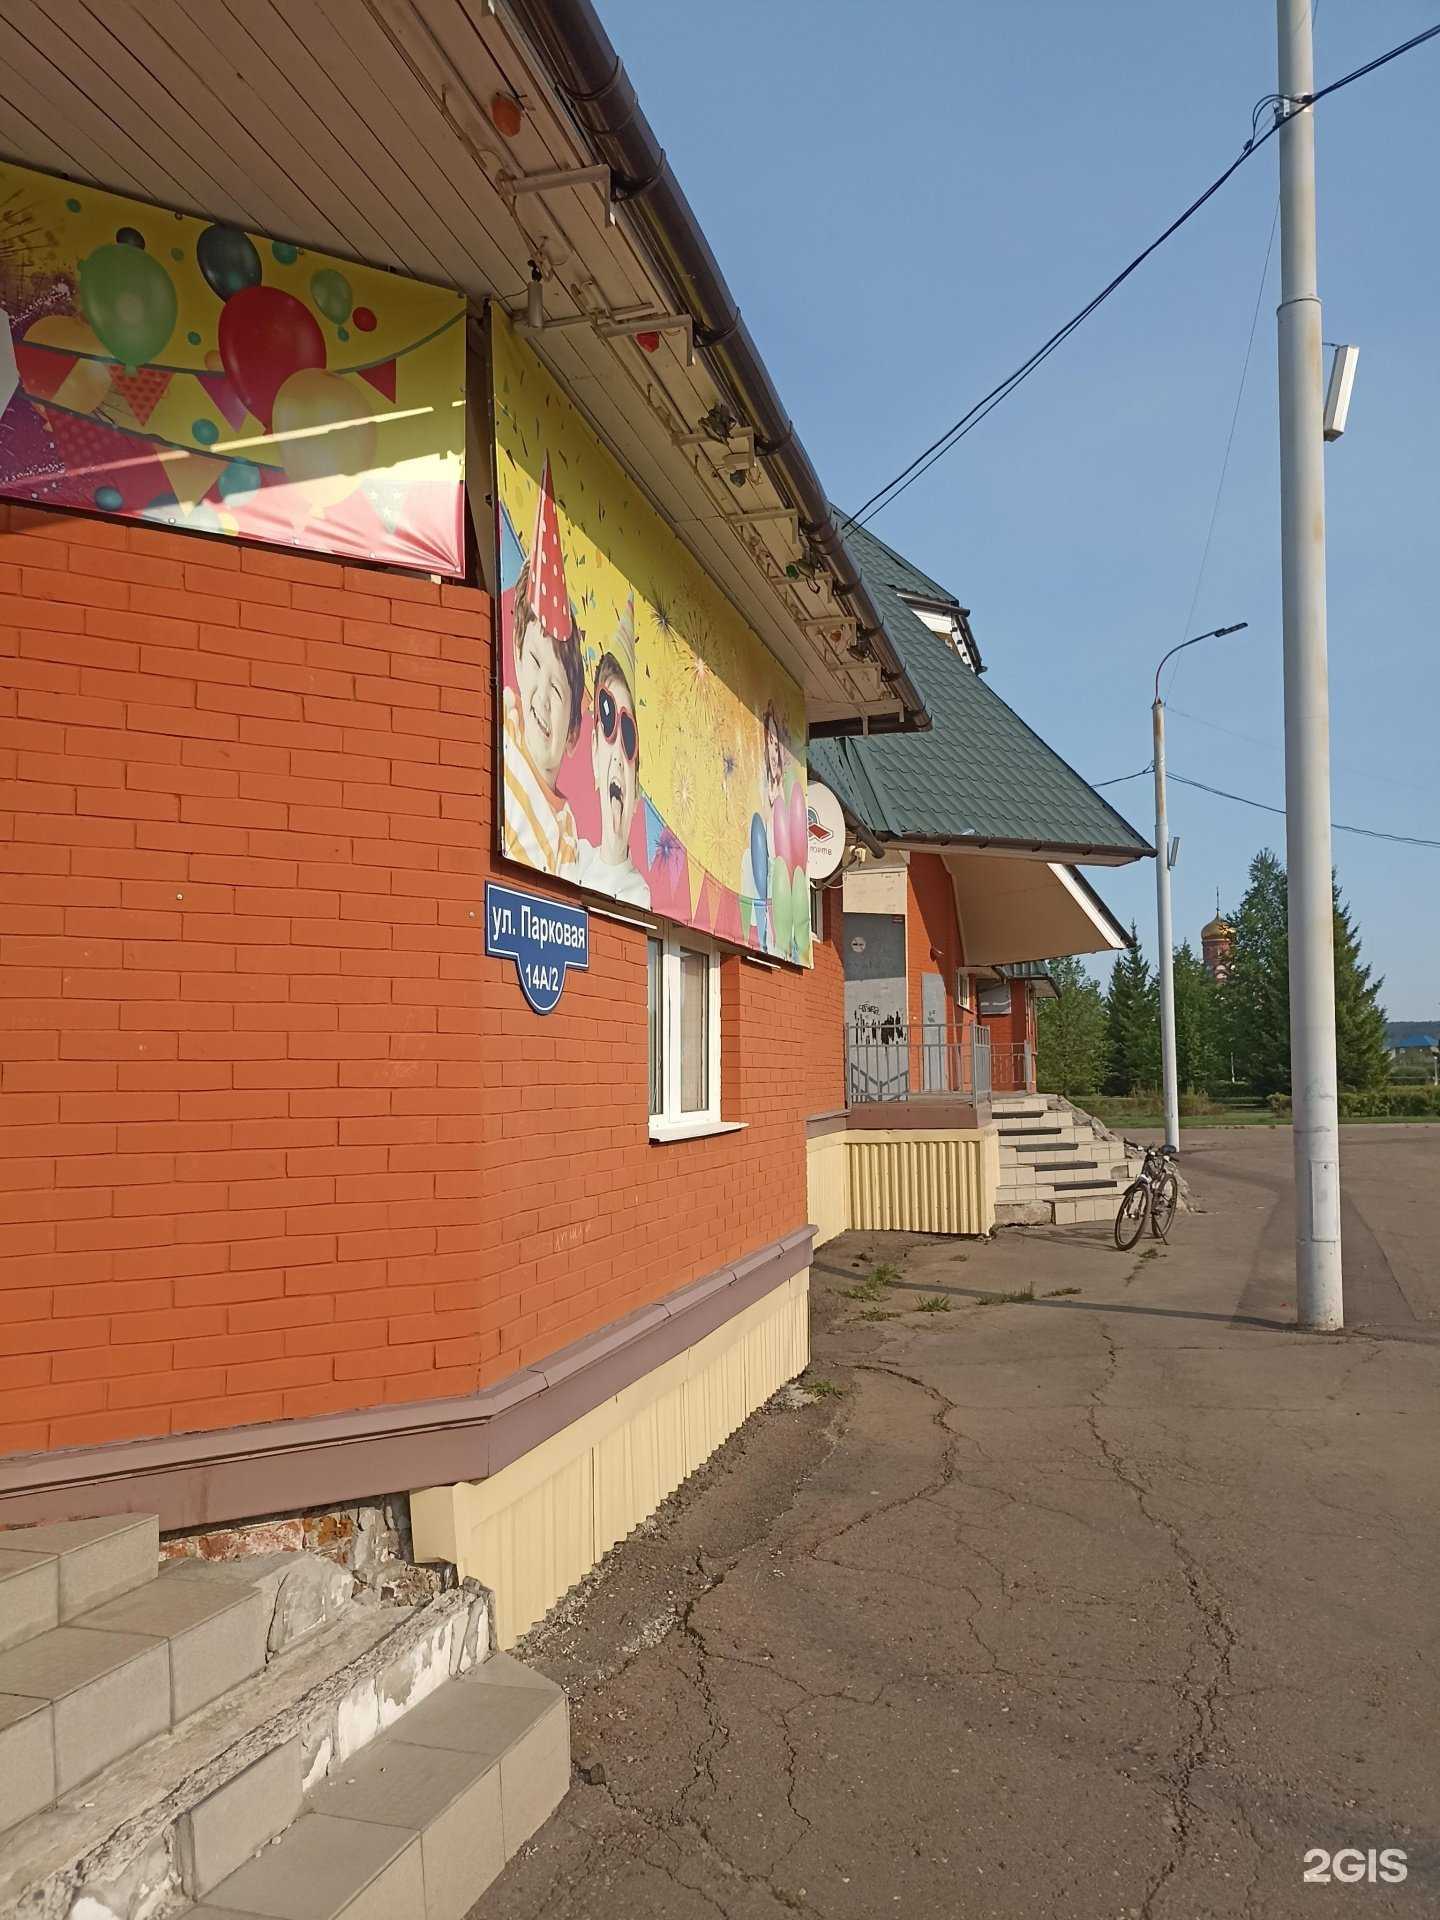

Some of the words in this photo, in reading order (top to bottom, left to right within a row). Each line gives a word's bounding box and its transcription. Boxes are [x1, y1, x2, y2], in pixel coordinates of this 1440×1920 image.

[492, 906, 516, 941] ул.
[521, 905, 585, 949] Парковая
[525, 963, 559, 991] 14А/2
